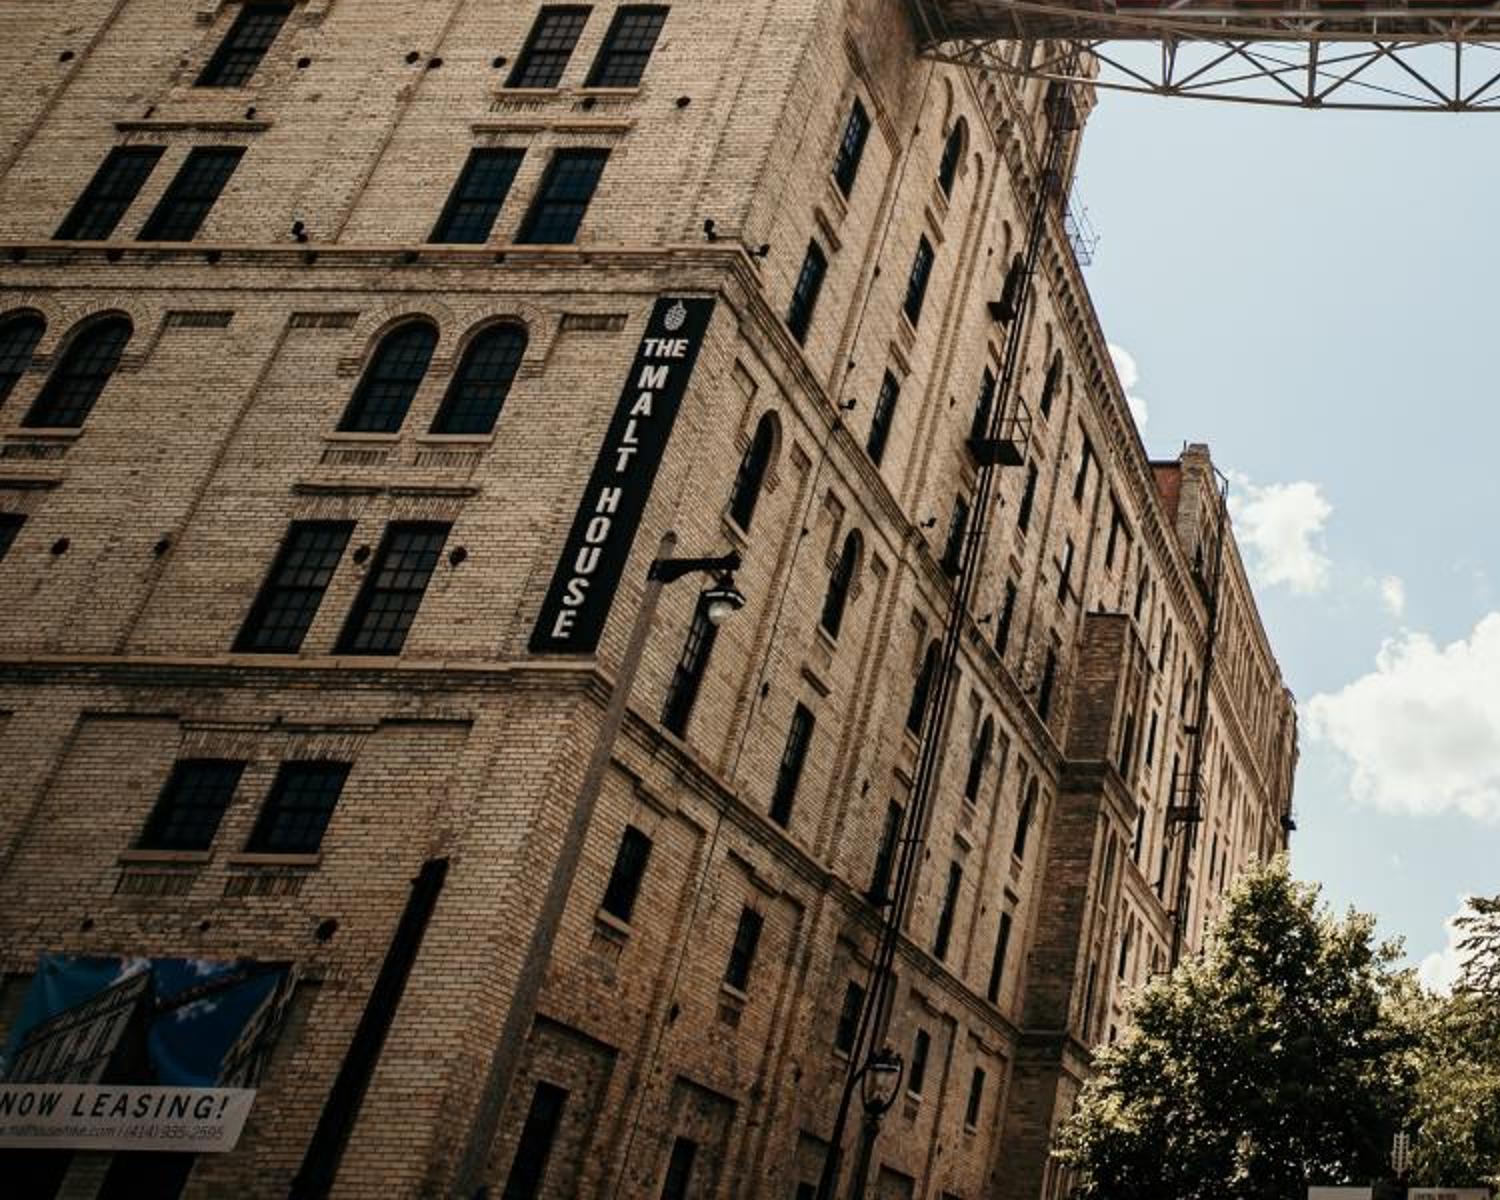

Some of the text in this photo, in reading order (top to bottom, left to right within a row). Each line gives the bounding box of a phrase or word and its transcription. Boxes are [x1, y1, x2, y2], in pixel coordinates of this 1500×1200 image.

[551, 338, 689, 640] THE MALT HOUSE
[0, 1092, 230, 1120] NOW LEASING!
